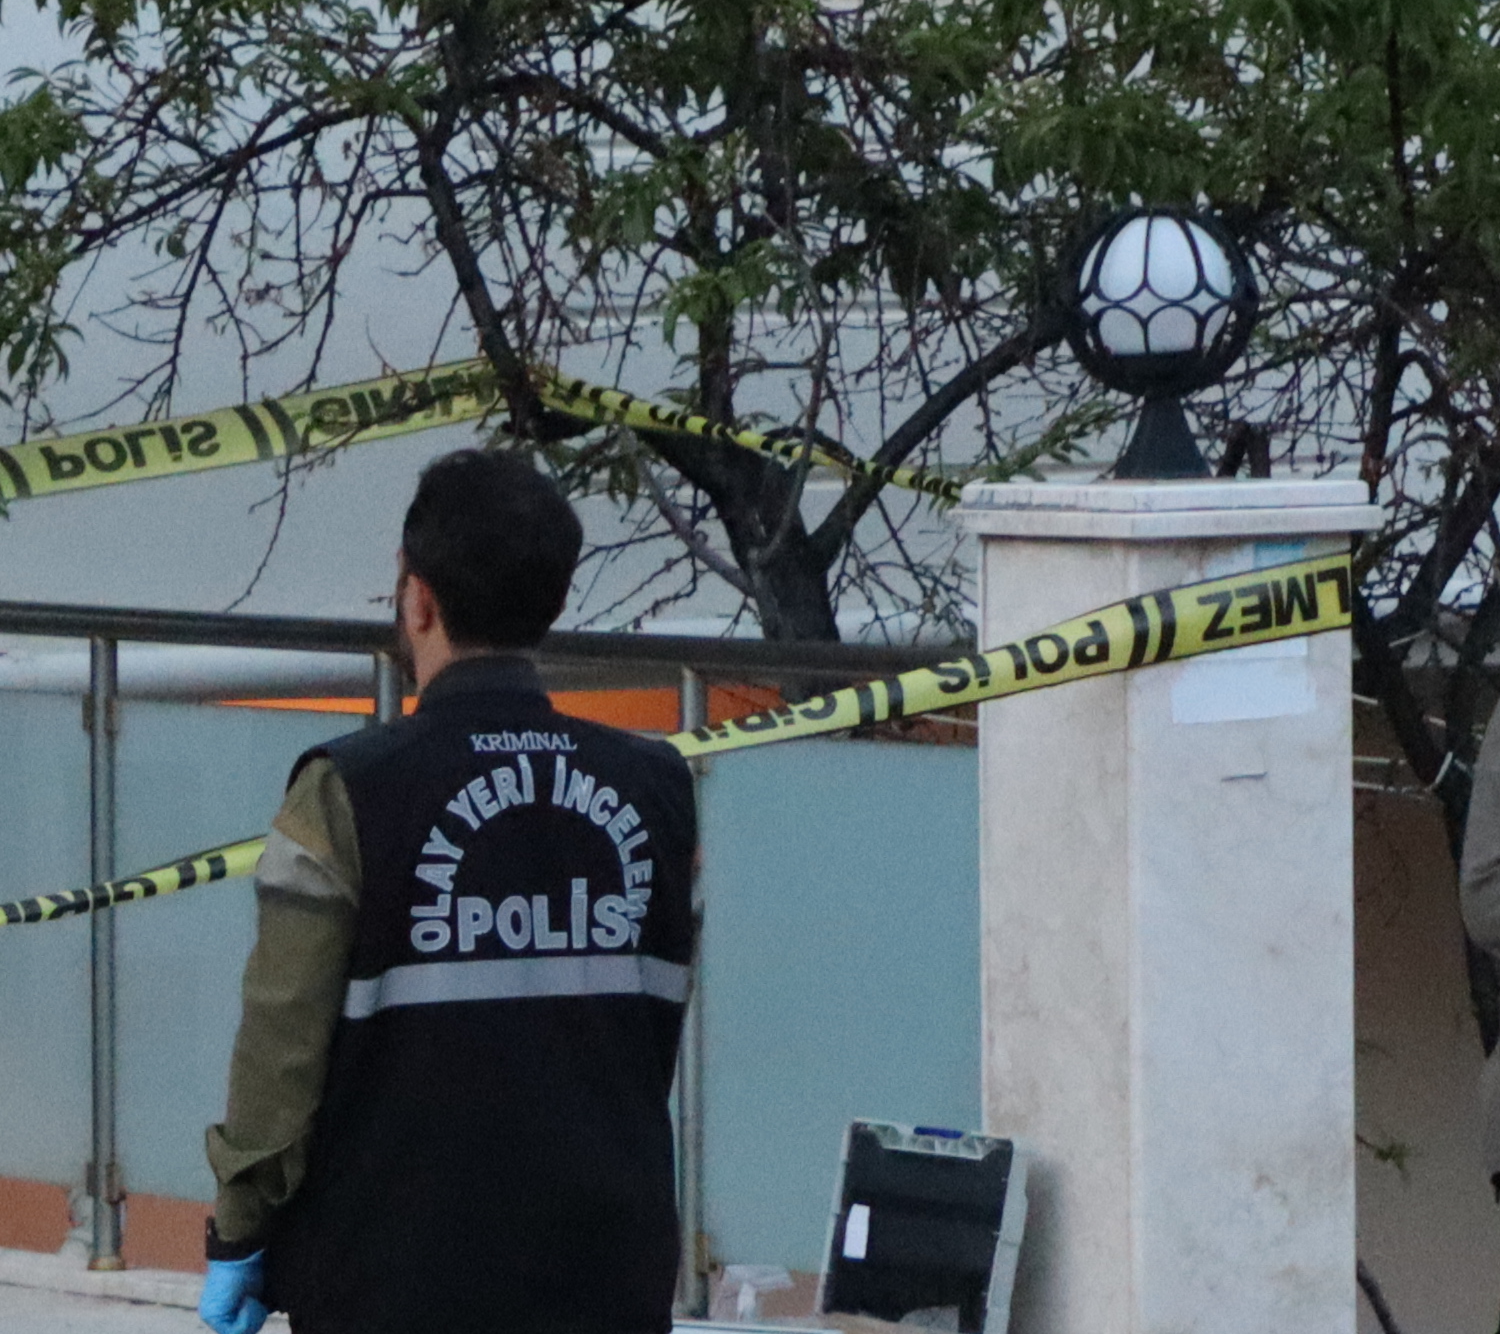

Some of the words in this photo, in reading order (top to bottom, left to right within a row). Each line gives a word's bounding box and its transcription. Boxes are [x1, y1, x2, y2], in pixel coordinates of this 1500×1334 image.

[411, 826, 464, 954] OLAY
[446, 754, 536, 832] YERİ
[457, 877, 632, 953] POLİS
